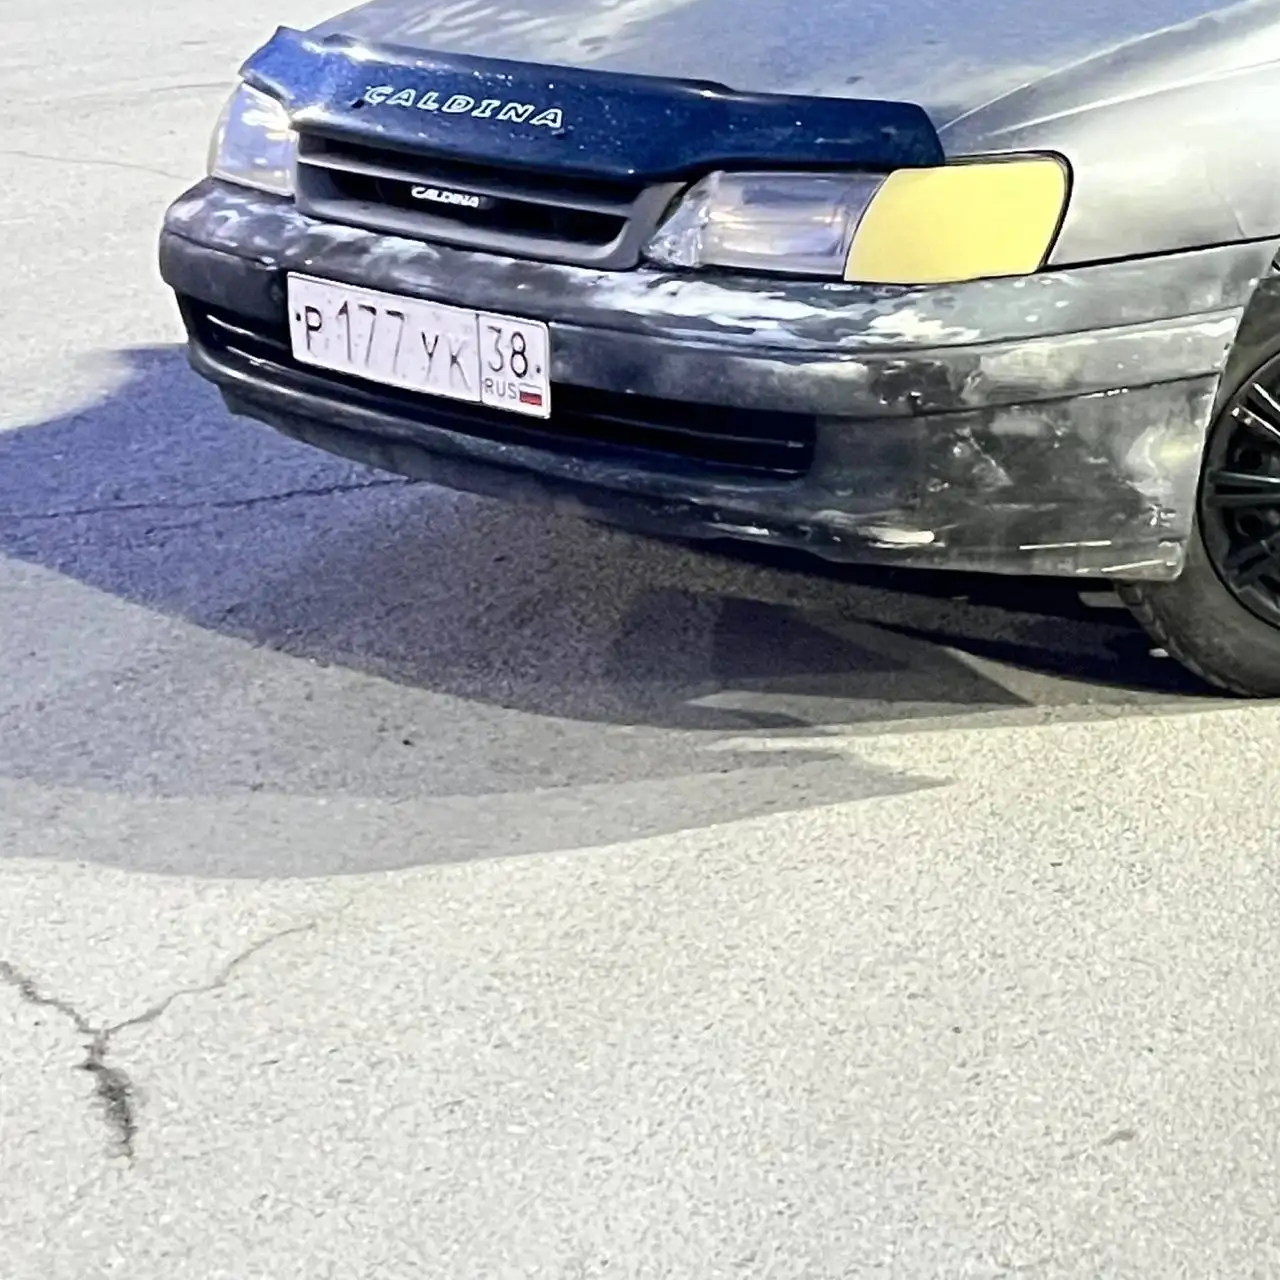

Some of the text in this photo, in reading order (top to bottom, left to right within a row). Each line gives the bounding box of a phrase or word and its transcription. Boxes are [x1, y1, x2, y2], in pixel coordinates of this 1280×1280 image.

[363, 85, 564, 128] CALDINA
[487, 325, 528, 378] 38
[484, 377, 517, 400] RUS
